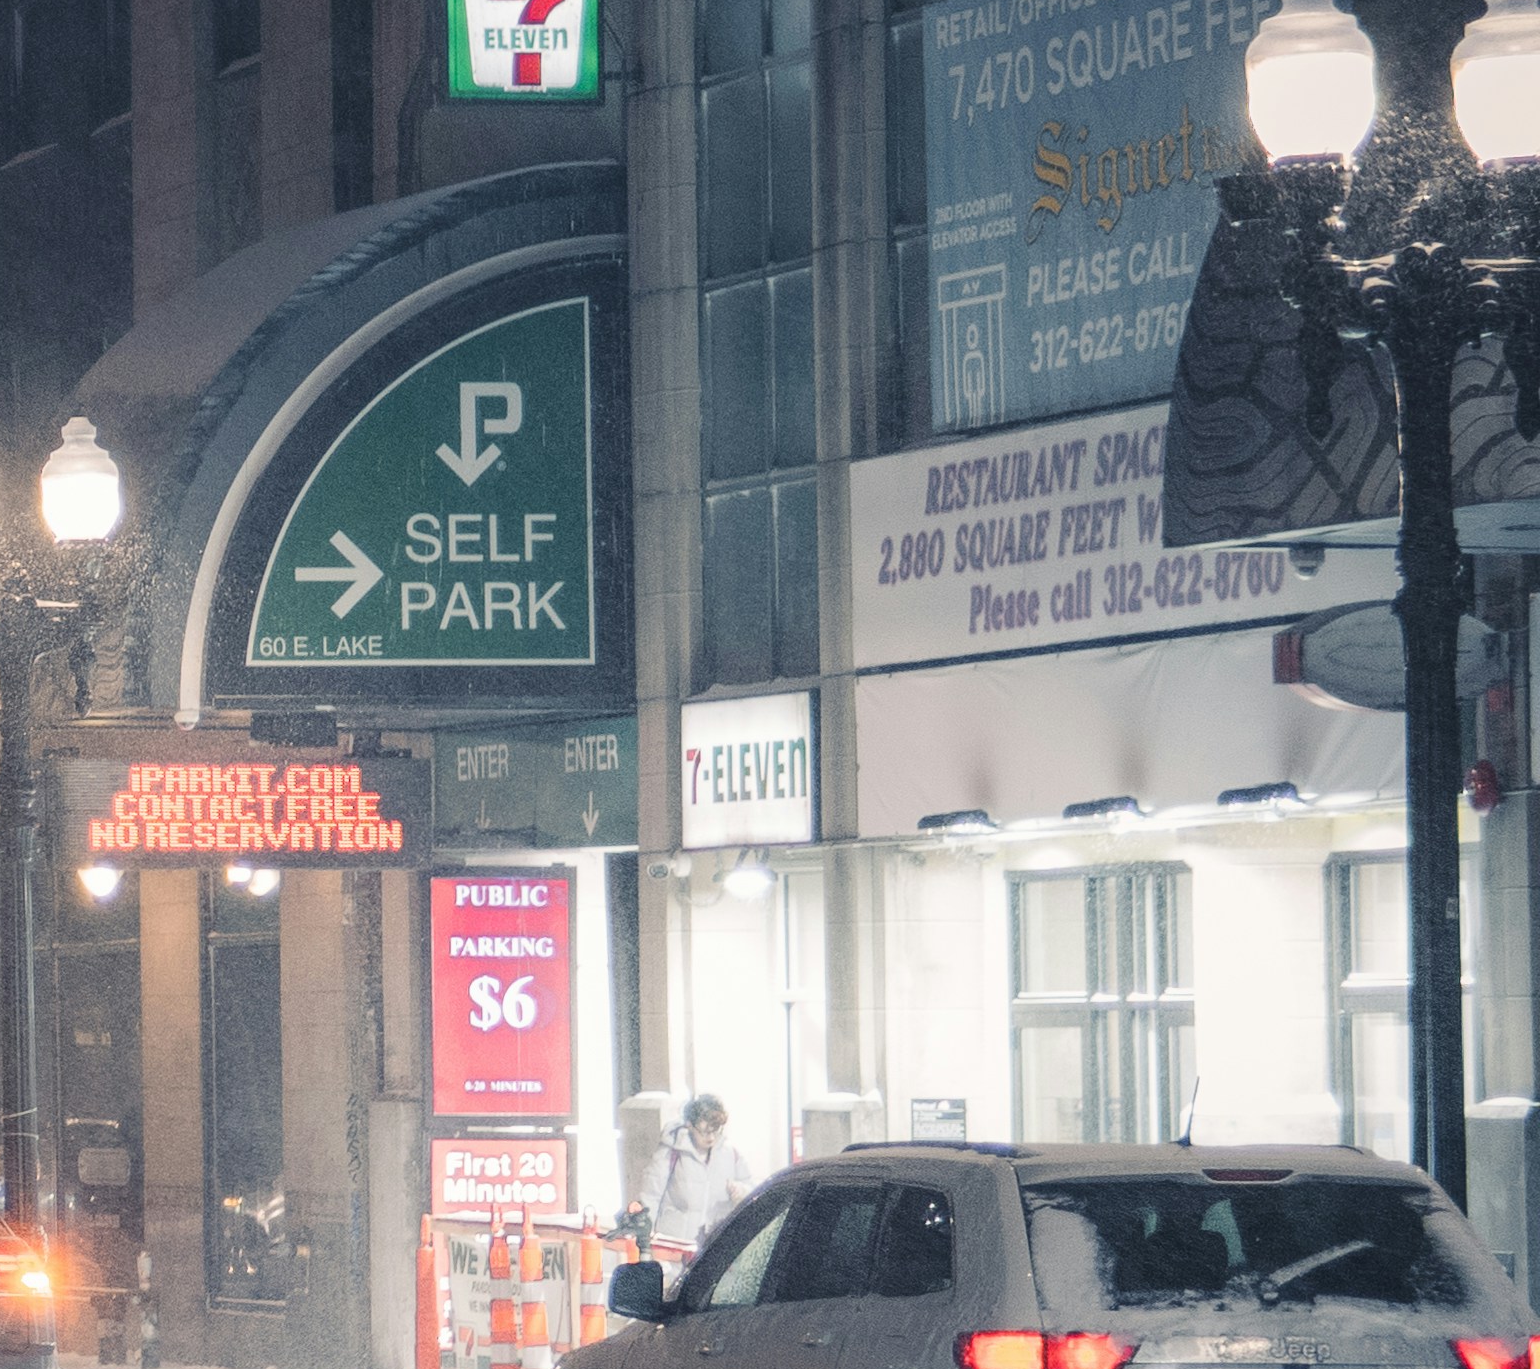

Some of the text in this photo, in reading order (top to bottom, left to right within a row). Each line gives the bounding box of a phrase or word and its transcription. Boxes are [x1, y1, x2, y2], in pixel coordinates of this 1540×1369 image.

[948, 45, 1035, 126] 7,470
[1046, 0, 1192, 95] SQUARE
[1028, 104, 1193, 245] Signet
[954, 198, 986, 220] FLOOR
[988, 192, 1013, 211] WITH
[932, 216, 1017, 250] ELEVATOR ACCESS
[1027, 232, 1195, 308] PLEASE CALL
[1031, 299, 1191, 373] 312-622-876
[925, 439, 1086, 516] RESTAURANT
[405, 513, 557, 563] SELF
[878, 528, 946, 585] 2,880
[954, 511, 1050, 574] SQUARE
[1057, 498, 1126, 557] FEET
[400, 582, 566, 630] PARK
[968, 551, 1286, 634] Please call 312-622-8760
[259, 635, 383, 657] 60 E. LAKE
[456, 745, 509, 781] ENTER
[564, 734, 620, 772] ENTER
[130, 765, 362, 793] iPARKIT.COM
[114, 794, 382, 821] CONTACT FREE
[90, 822, 403, 850] NO RESERVATION
[455, 884, 548, 907] PUBLIC
[449, 936, 554, 958] PARKING
[467, 975, 537, 1032] $6
[490, 1080, 543, 1093] MINUTES
[445, 1152, 554, 1177] First 20
[443, 1179, 557, 1204] Minutes
[451, 1240, 478, 1275] WE
[1271, 1337, 1331, 1363] Jeep
